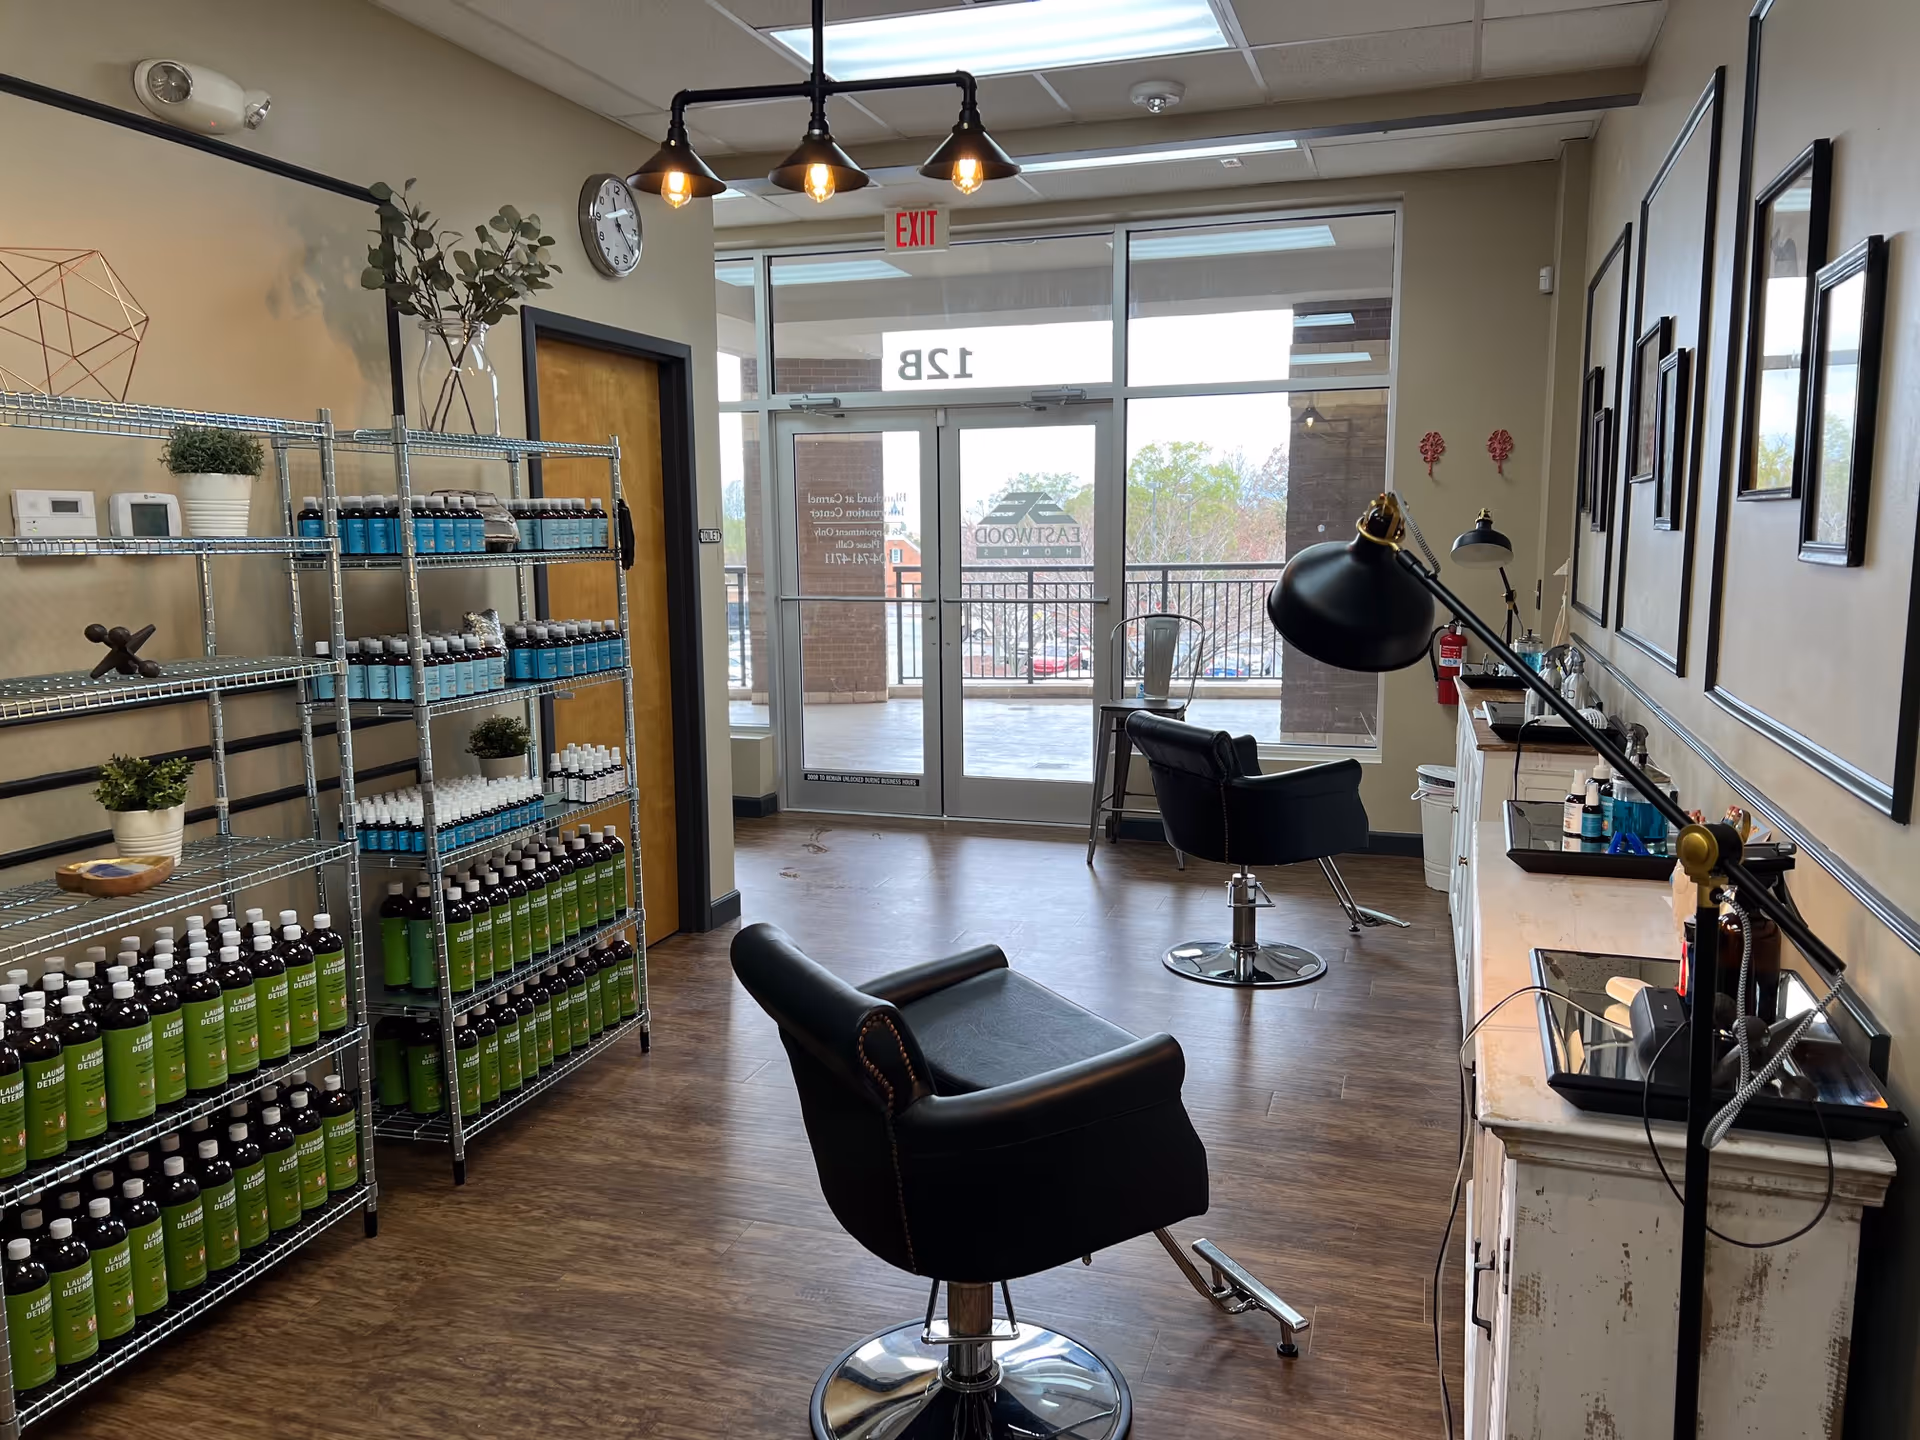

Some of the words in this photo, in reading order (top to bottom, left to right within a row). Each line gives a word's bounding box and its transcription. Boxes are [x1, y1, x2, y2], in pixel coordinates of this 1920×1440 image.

[614, 185, 620, 196] 12
[600, 196, 604, 205] 10
[596, 212, 601, 221] 9
[629, 210, 634, 219] 2
[896, 210, 937, 247] EXIT
[600, 232, 605, 241] 8
[605, 247, 610, 257] 7
[614, 256, 619, 265] 6
[623, 254, 628, 264] 5
[701, 530, 718, 540] TOILET
